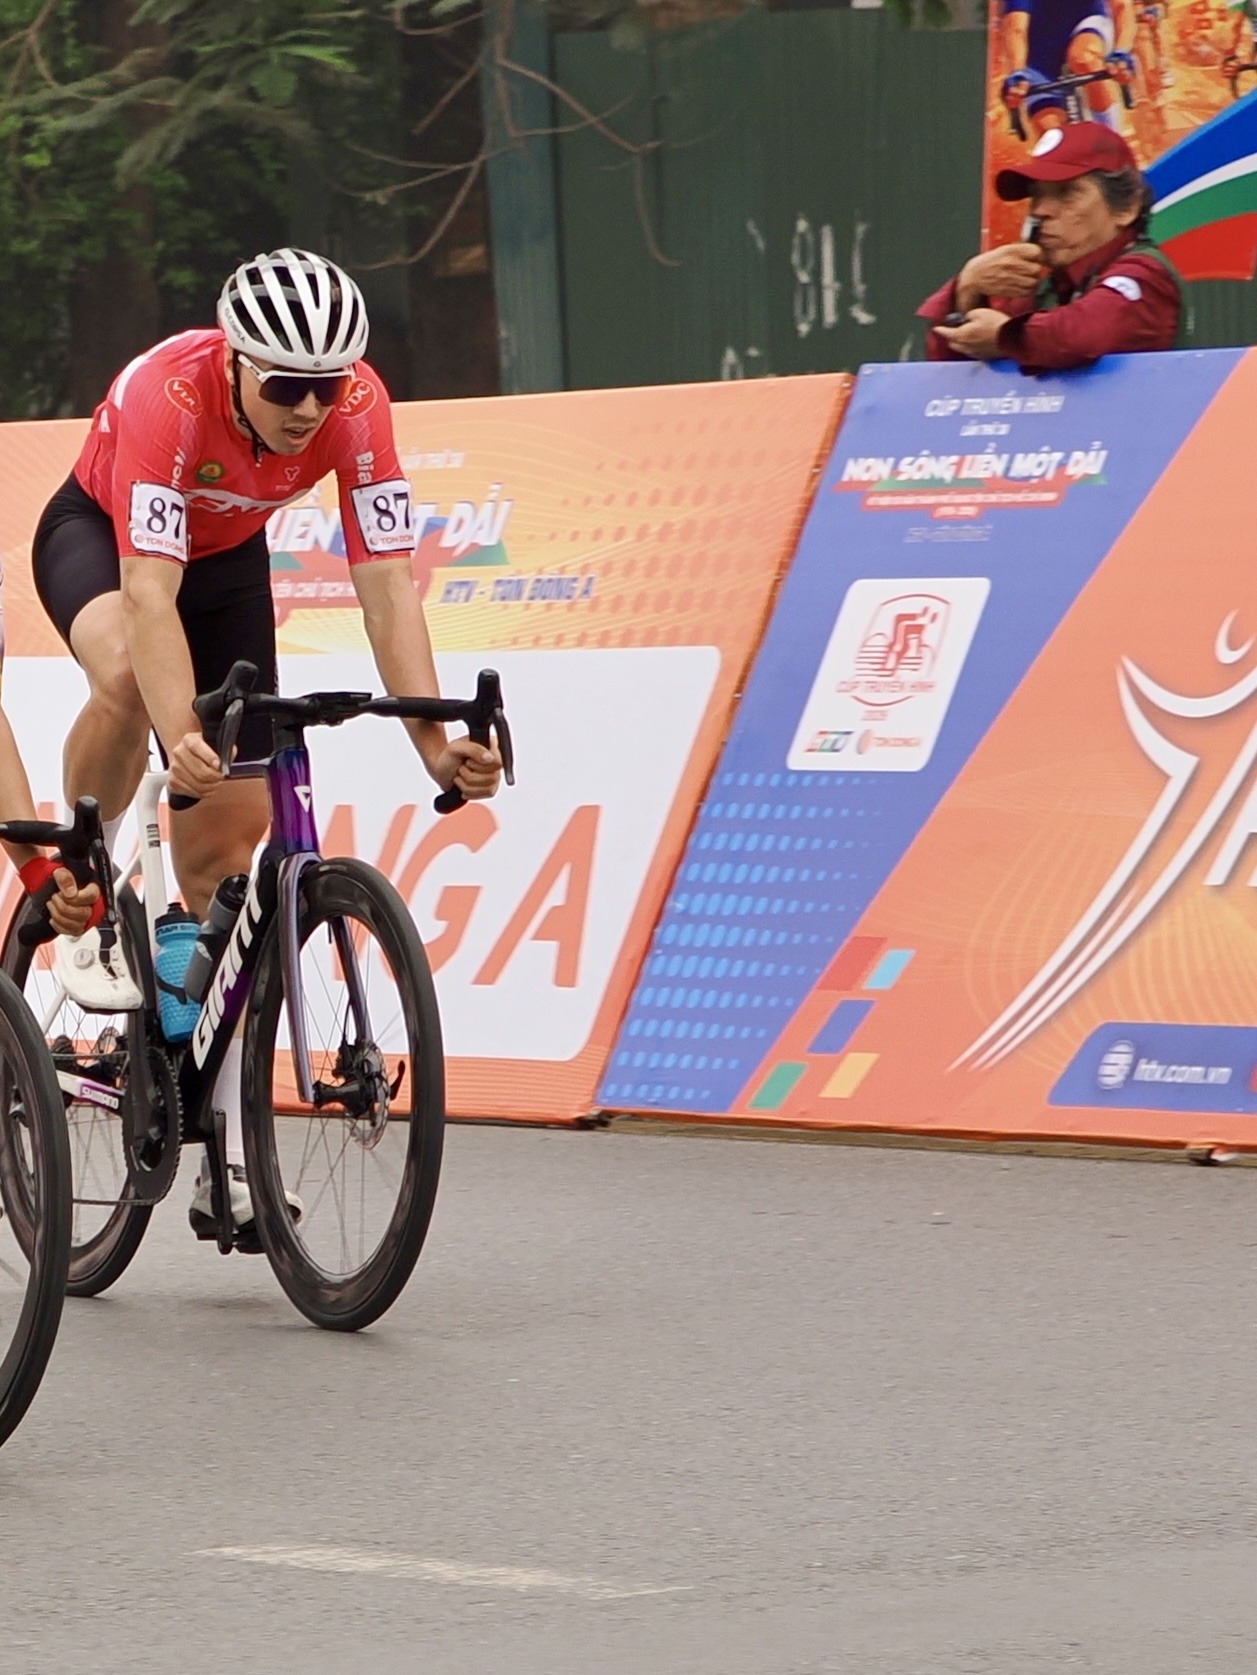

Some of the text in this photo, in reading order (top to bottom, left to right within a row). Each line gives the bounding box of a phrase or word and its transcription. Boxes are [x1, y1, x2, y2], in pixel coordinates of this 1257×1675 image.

[339, 382, 371, 414] VDC
[841, 456, 895, 482] NON
[146, 497, 184, 540] 87
[372, 491, 411, 533] 87
[193, 843, 264, 1071] GIANT
